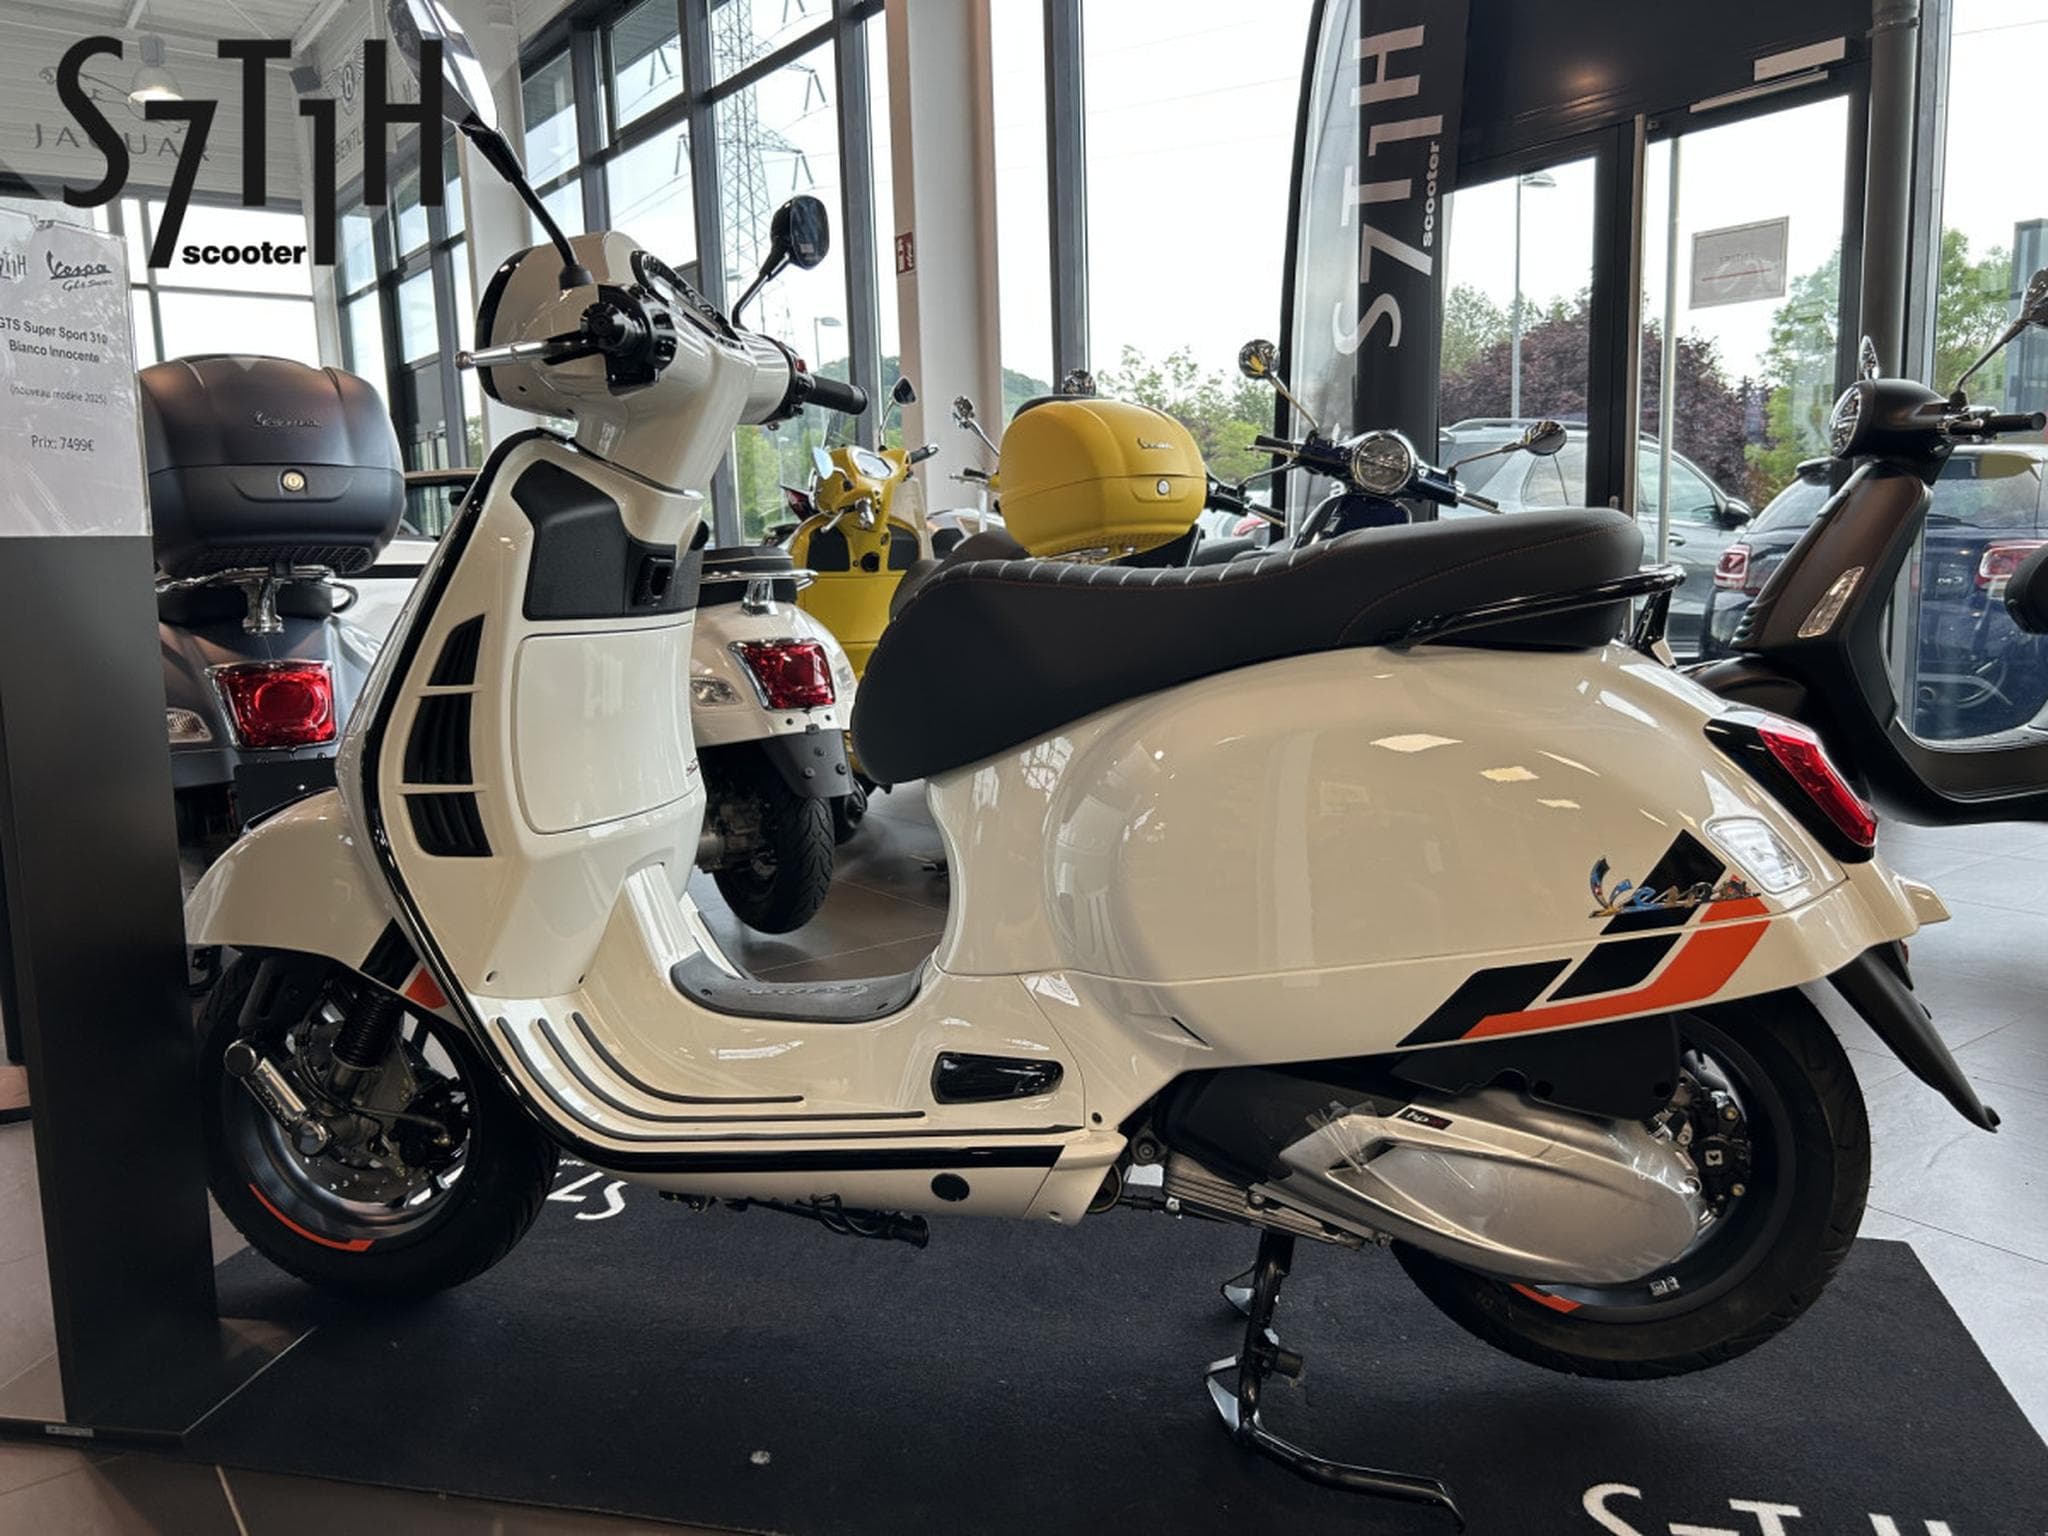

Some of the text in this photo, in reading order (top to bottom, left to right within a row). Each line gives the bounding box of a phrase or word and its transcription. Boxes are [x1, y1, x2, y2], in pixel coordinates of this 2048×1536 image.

[35, 123, 211, 162] JAUA
[1423, 141, 1440, 248] scooter
[45, 250, 112, 280] Vespa
[0, 316, 20, 331] GTS
[23, 320, 56, 337] Super
[59, 326, 88, 342] Sport
[9, 339, 47, 356] Bianco
[31, 434, 95, 452] Prix: 7499€
